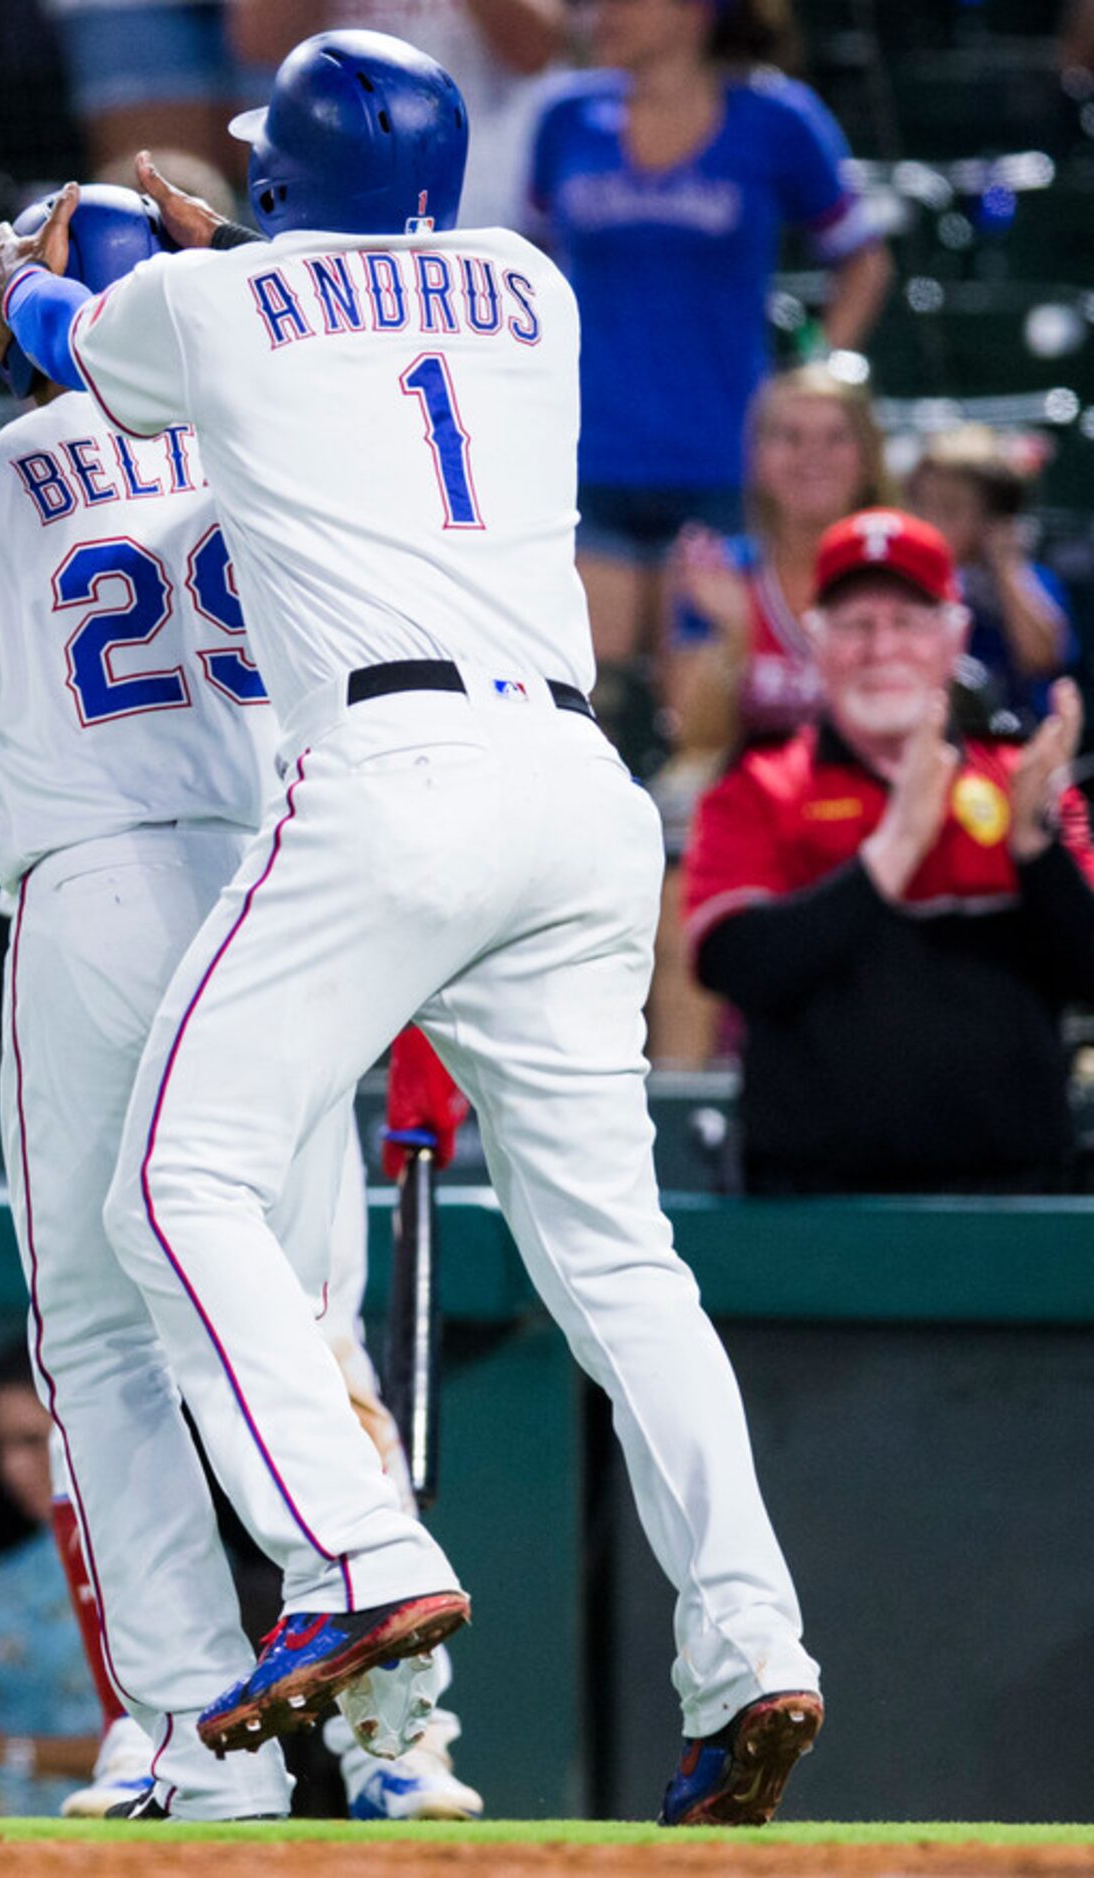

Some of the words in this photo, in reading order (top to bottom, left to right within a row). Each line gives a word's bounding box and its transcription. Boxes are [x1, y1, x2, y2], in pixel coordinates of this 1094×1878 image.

[418, 190, 428, 216] 1
[248, 250, 542, 350] ANDRUS
[10, 421, 208, 526] BELT
[399, 352, 485, 530] 1
[852, 512, 902, 561] T
[51, 523, 270, 728] 29
